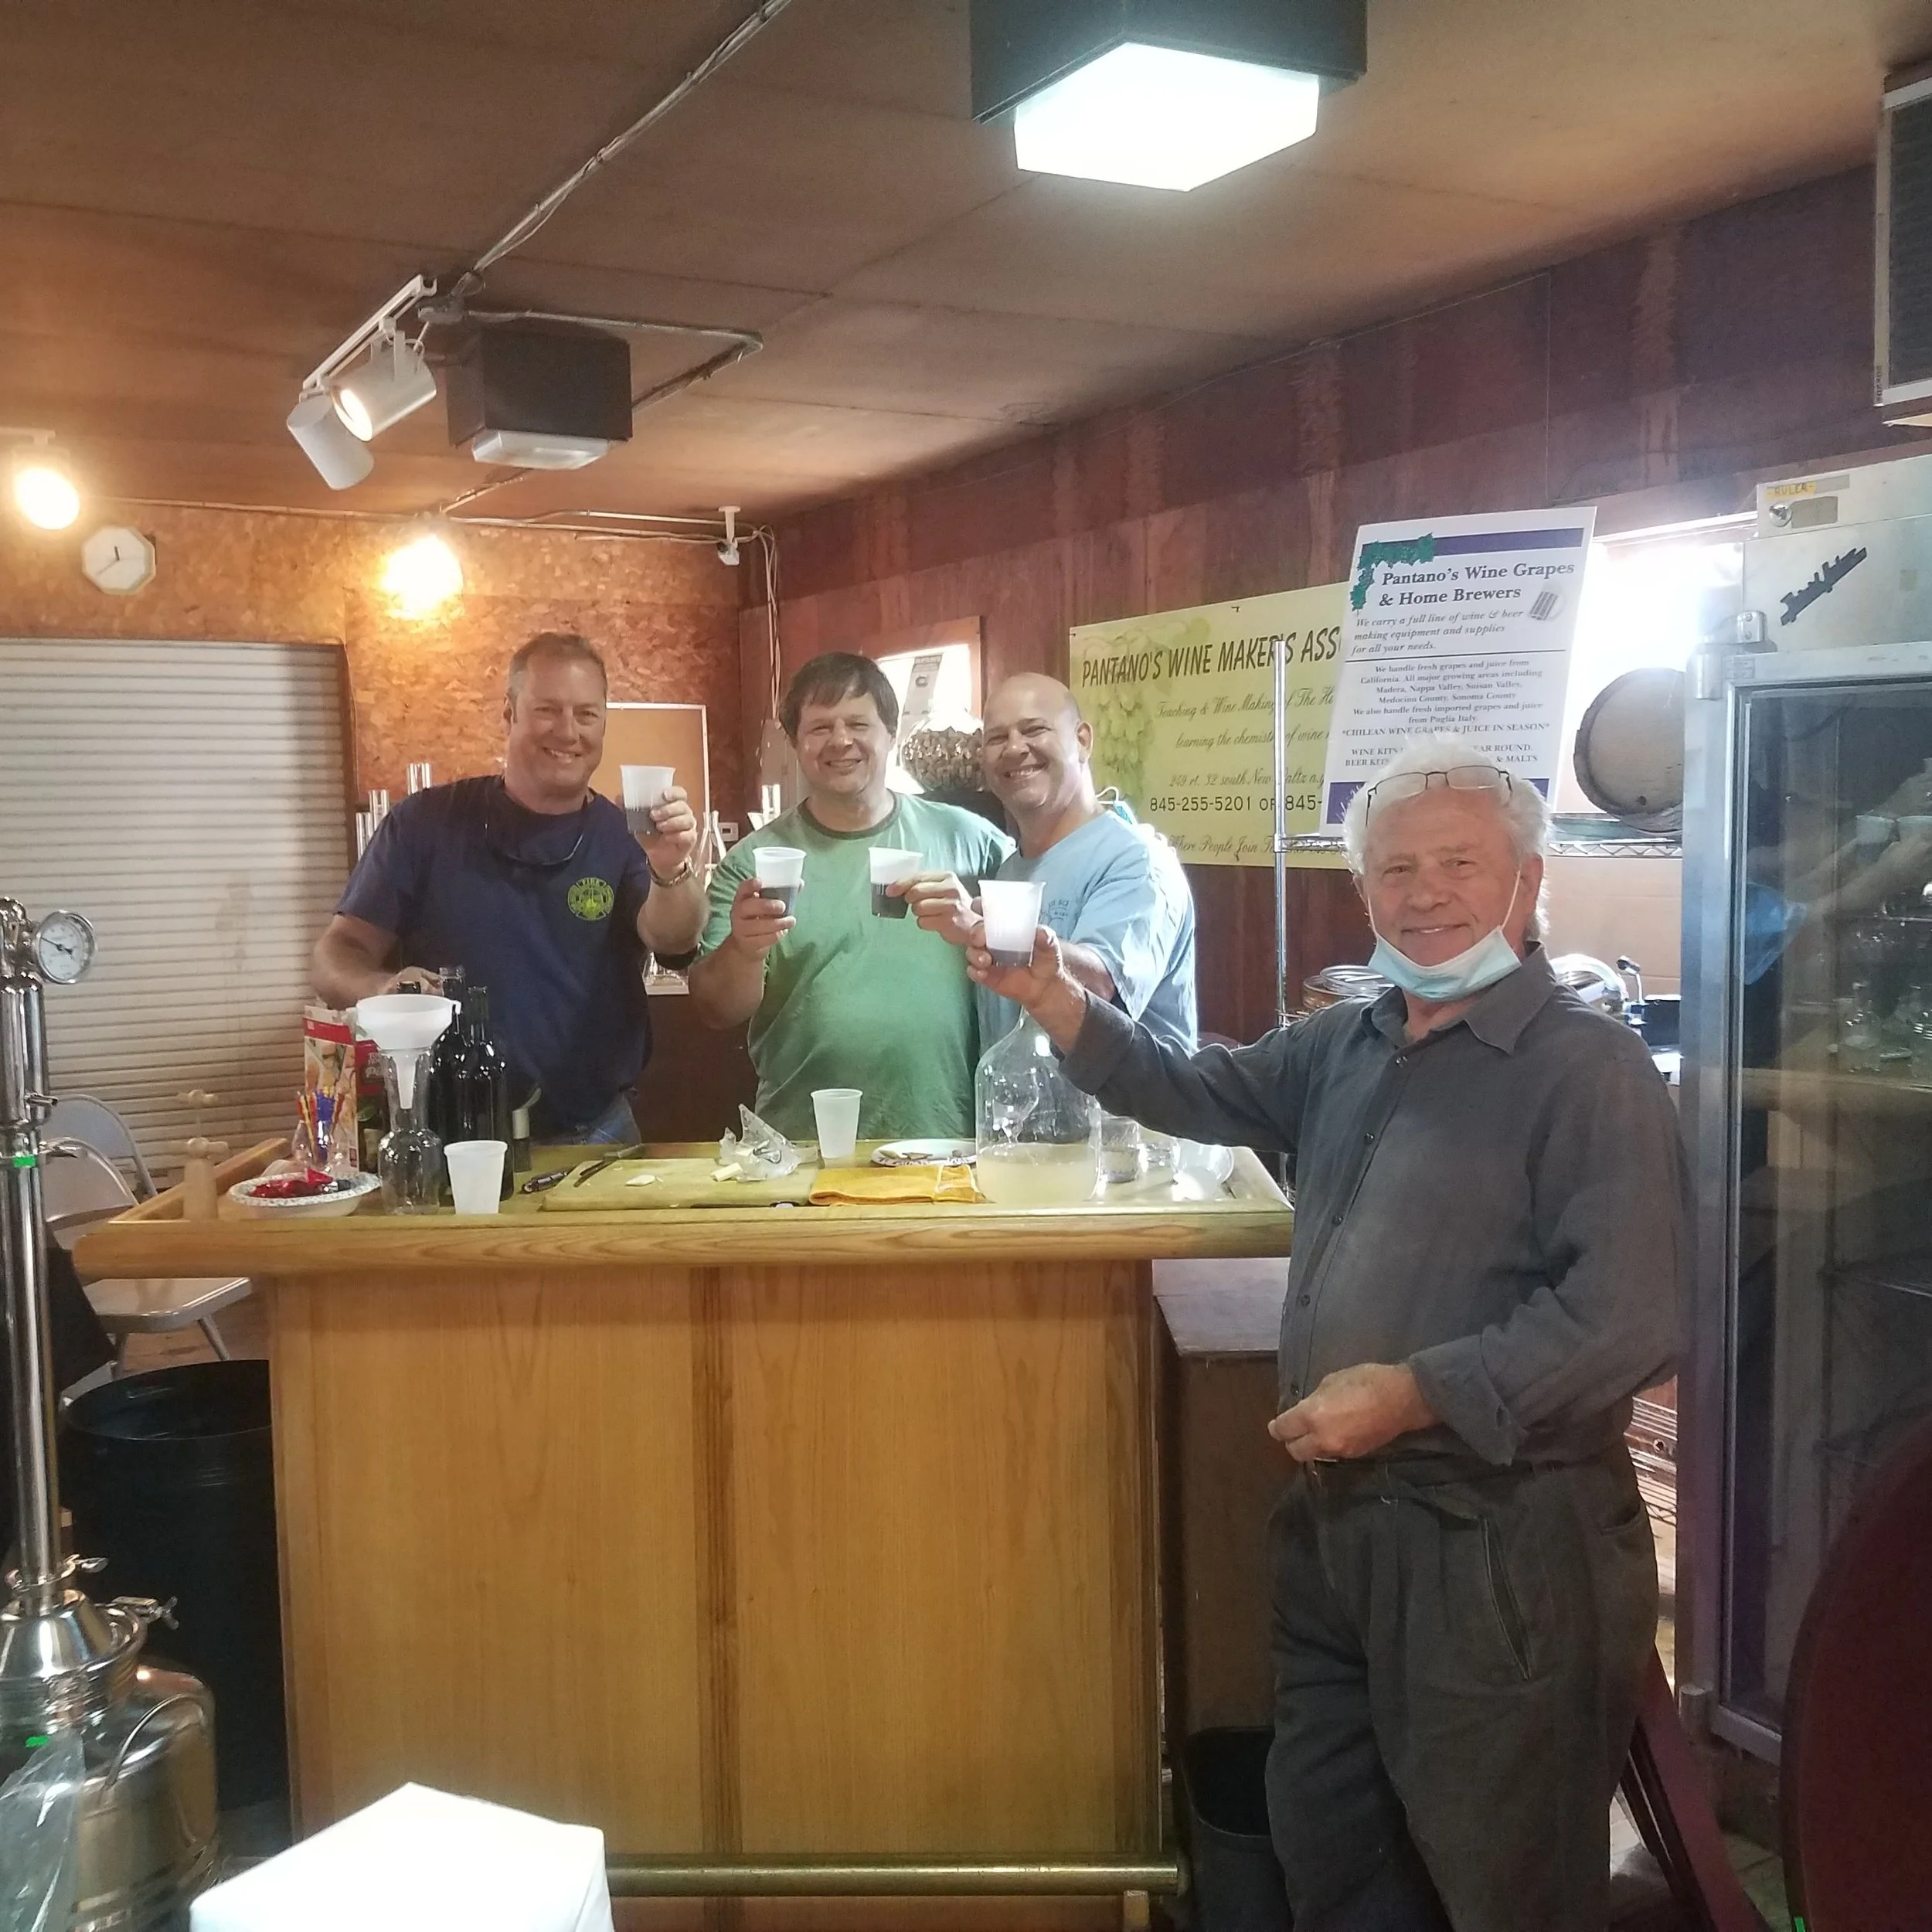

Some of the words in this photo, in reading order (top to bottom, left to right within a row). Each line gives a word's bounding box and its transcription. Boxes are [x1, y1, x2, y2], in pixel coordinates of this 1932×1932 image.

[1382, 568, 1459, 586] Pantano's
[1464, 565, 1508, 580] Wine
[1512, 562, 1574, 580] Grapes
[1379, 594, 1393, 607] &
[1399, 590, 1447, 605] Home
[1452, 587, 1521, 602] Brewers
[1356, 618, 1370, 628] We
[1371, 617, 1396, 628] carry
[1406, 614, 1425, 626] full
[1428, 614, 1444, 623] line
[1448, 612, 1461, 624] of
[1461, 611, 1485, 621] wine
[1488, 610, 1499, 619] &
[1502, 609, 1523, 618] beer
[1354, 631, 1388, 641] making
[1390, 628, 1440, 640] equipment
[1443, 625, 1462, 635] and
[1465, 624, 1505, 637] supplies
[1351, 645, 1367, 656] for
[1368, 644, 1381, 653] all
[1383, 645, 1405, 655] your
[1407, 641, 1437, 651] needs.
[1082, 651, 1162, 687] PANTANO'S
[1168, 644, 1213, 678] WINE
[1301, 626, 1342, 663] ASS
[1389, 664, 1416, 672] handle
[1417, 663, 1437, 672] fresh
[1440, 662, 1467, 672] grapes
[1468, 660, 1485, 668] and
[1485, 660, 1507, 669] juice
[1417, 674, 1440, 683] major
[1442, 672, 1475, 681] growing
[1502, 669, 1543, 678] including
[1410, 685, 1436, 694] Nappa
[1451, 692, 1484, 701] Sonoma
[1486, 692, 1517, 700] County
[1156, 701, 1197, 721] Teaching
[1199, 706, 1209, 715] &
[1213, 697, 1236, 715] Wine
[1294, 687, 1317, 708] The
[1412, 705, 1432, 713] fresh
[1434, 702, 1472, 713] imported
[1474, 703, 1502, 713] grapes
[1503, 702, 1519, 710] and
[1521, 701, 1543, 711] juice
[1408, 716, 1427, 724] from
[1430, 715, 1455, 725] Puglia
[1462, 724, 1491, 734] JUICE
[1175, 732, 1213, 751] learning
[1216, 730, 1231, 746] the
[1285, 724, 1301, 748] of
[1298, 730, 1325, 742] wine
[1505, 754, 1539, 763] MALTS
[1206, 773, 1219, 786] 32
[1220, 769, 1249, 786] south
[1247, 767, 1274, 786] New
[1284, 766, 1308, 784] altz
[1150, 796, 1250, 811] 845-255-5201
[1199, 834, 1233, 858] People
[1233, 835, 1258, 862] Join
